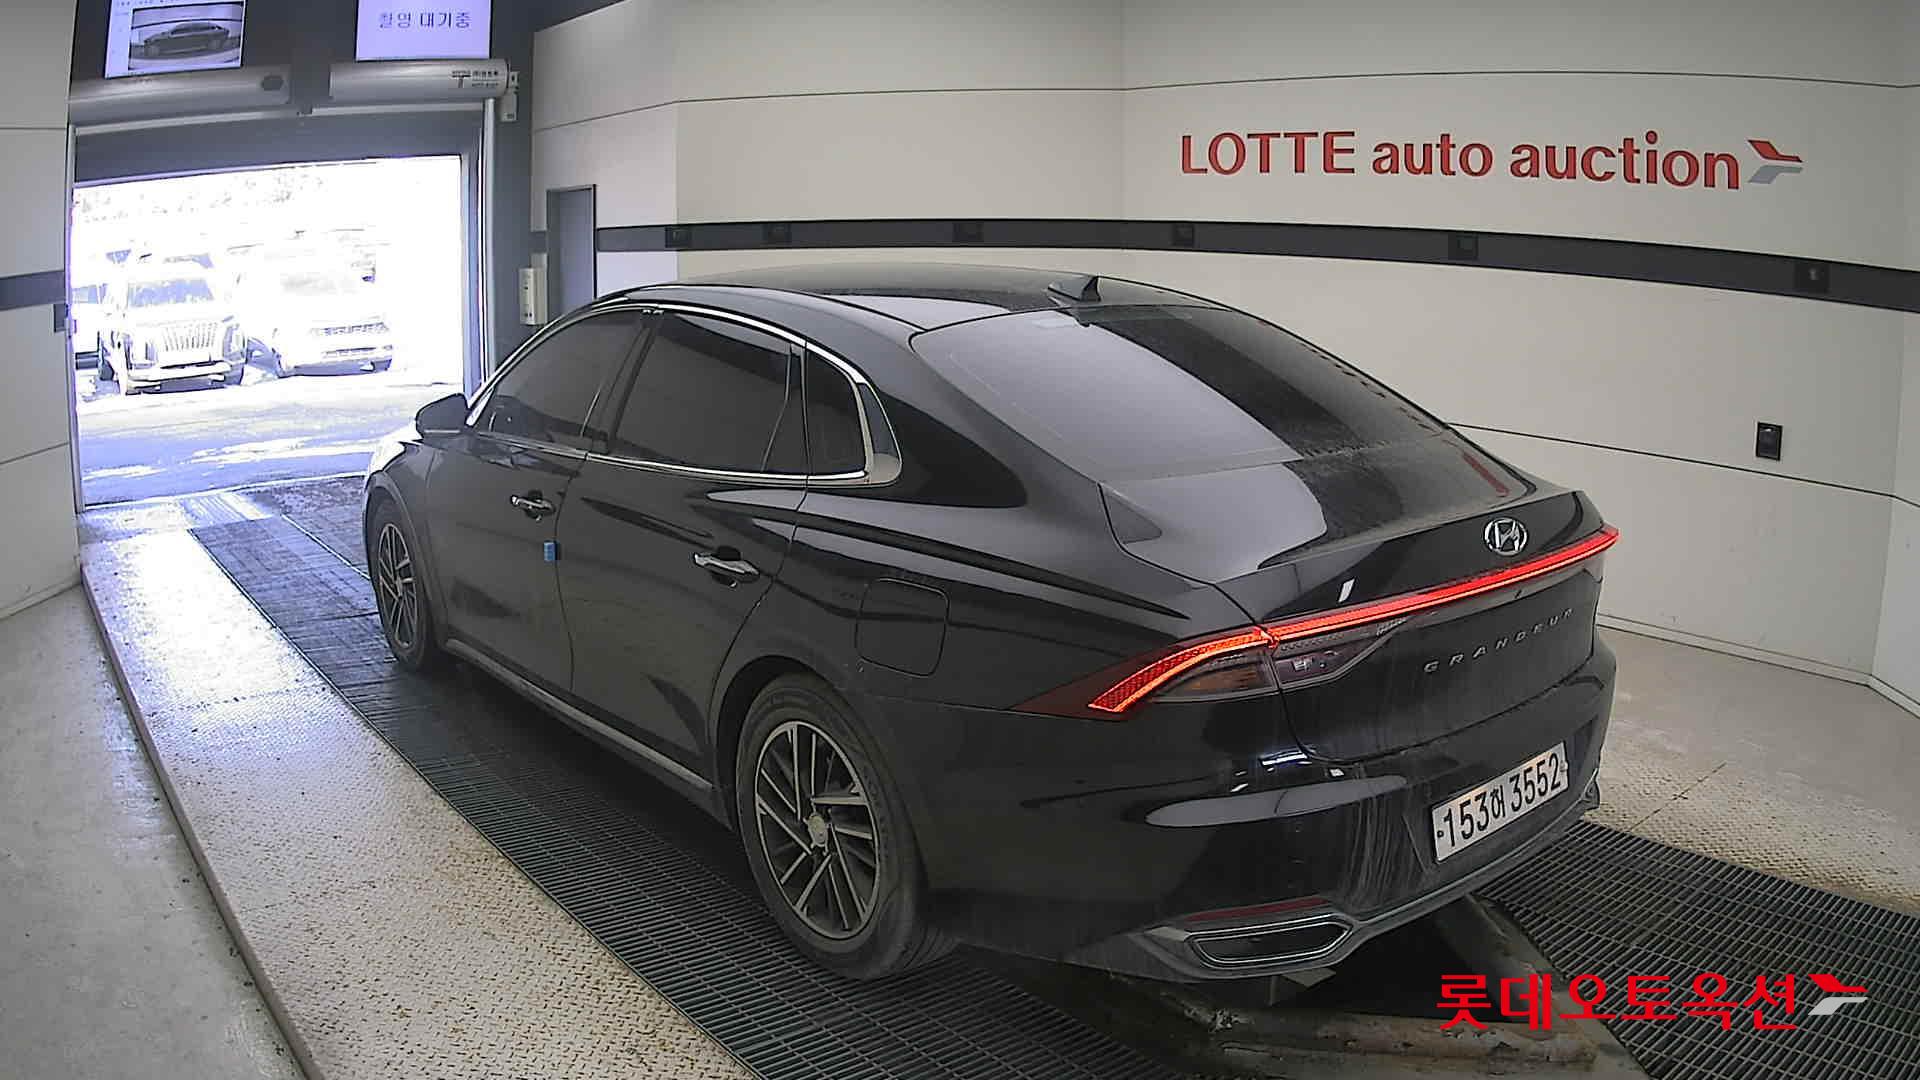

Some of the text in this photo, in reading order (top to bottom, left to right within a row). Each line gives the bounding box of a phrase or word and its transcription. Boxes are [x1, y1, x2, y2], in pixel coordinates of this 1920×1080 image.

[420, 11, 470, 29] 대기중
[1181, 130, 1740, 189] LOTTE auto auction
[1423, 607, 1573, 673] GRANDEUR
[1443, 752, 1561, 848] 153허 3552
